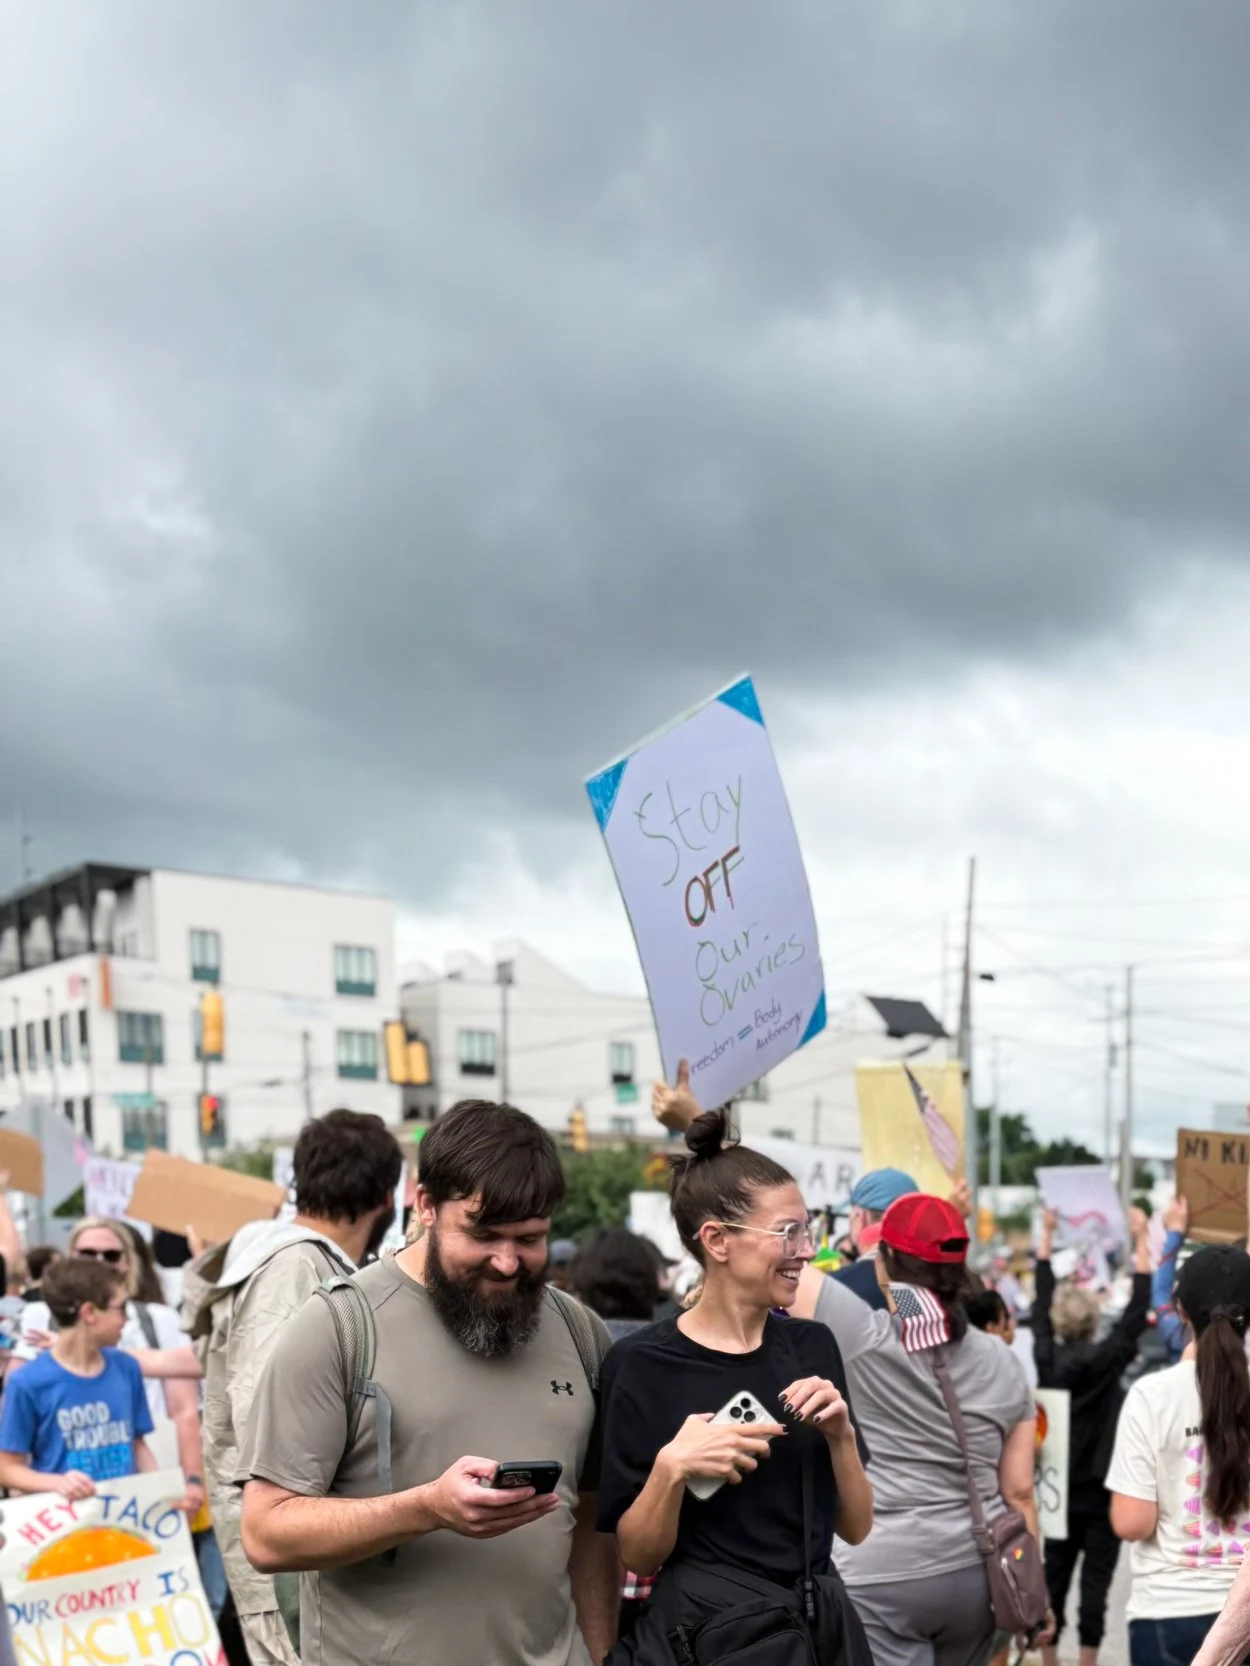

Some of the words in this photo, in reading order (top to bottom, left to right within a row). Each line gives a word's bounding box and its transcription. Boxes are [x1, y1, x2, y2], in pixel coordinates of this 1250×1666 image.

[633, 774, 741, 887] Stay
[685, 846, 744, 927] OFF
[695, 922, 758, 982] Our
[700, 934, 805, 1026] Ovaries
[690, 1036, 734, 1076] reedom
[754, 996, 781, 1029] Body
[1221, 1140, 1247, 1166] KI
[57, 1401, 110, 1431] GOOD
[17, 1498, 80, 1545] HEY
[95, 1494, 183, 1540] TACO
[7, 1599, 53, 1626] OUR
[55, 1579, 142, 1619] COUNTRY
[157, 1566, 190, 1598] IS
